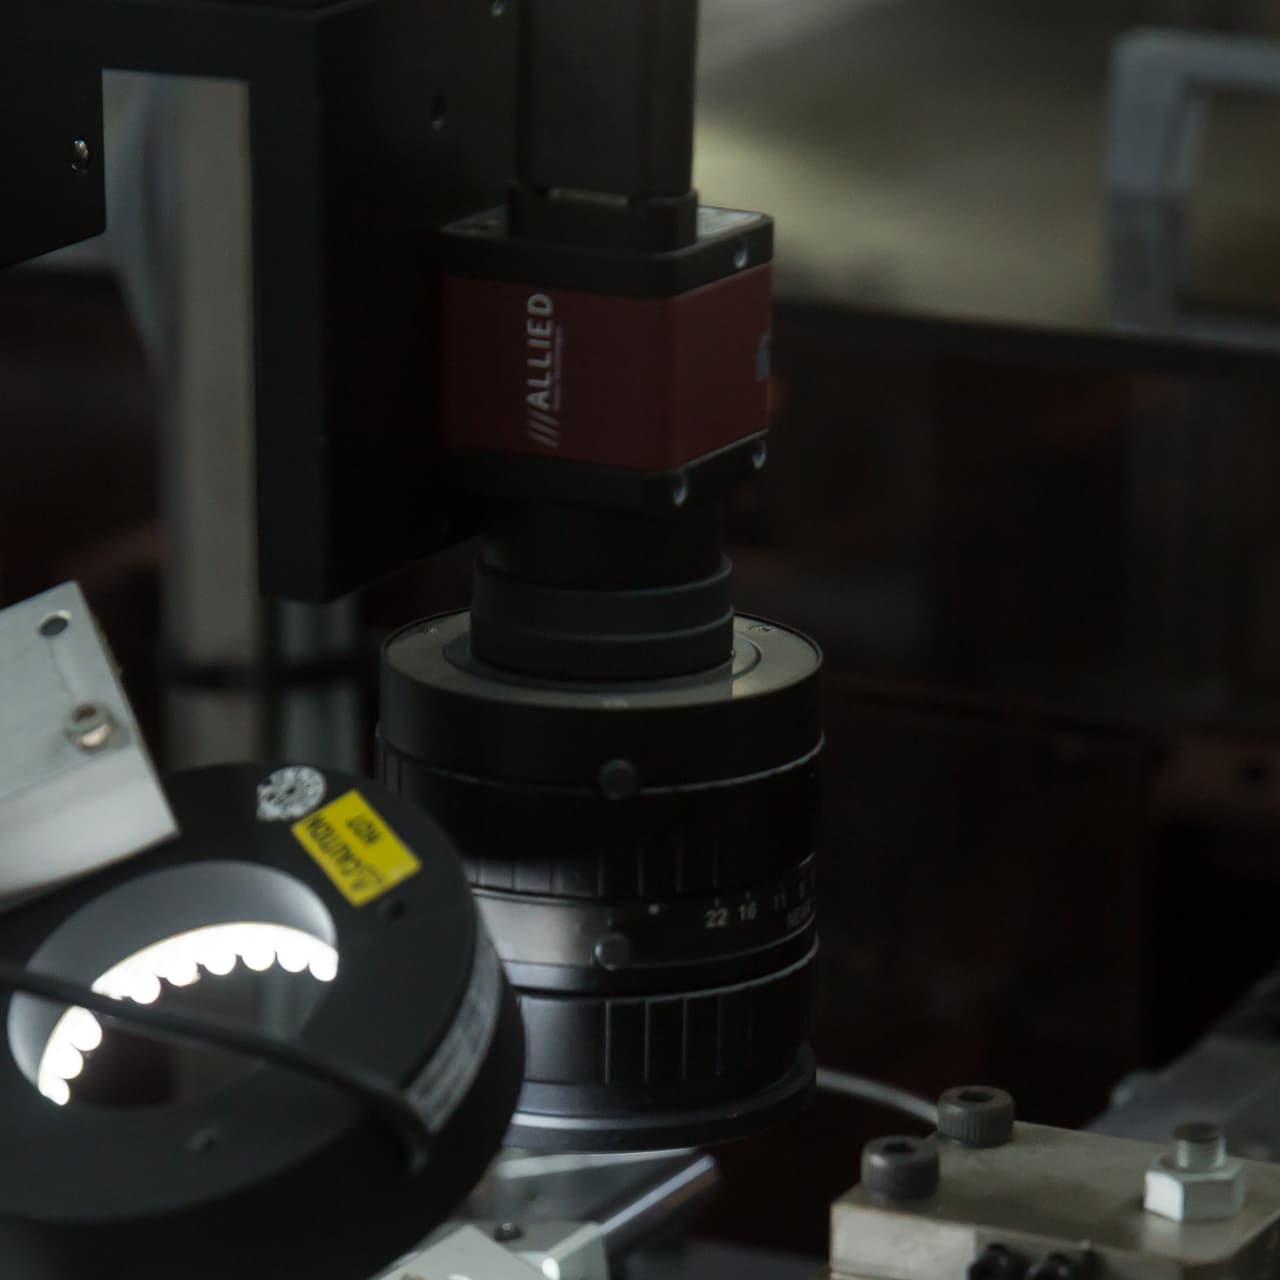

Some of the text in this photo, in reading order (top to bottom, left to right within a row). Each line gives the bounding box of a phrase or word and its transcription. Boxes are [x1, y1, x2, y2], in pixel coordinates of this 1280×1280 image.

[526, 292, 553, 411] ALLIED
[705, 907, 728, 928] 22
[738, 901, 757, 921] 16
